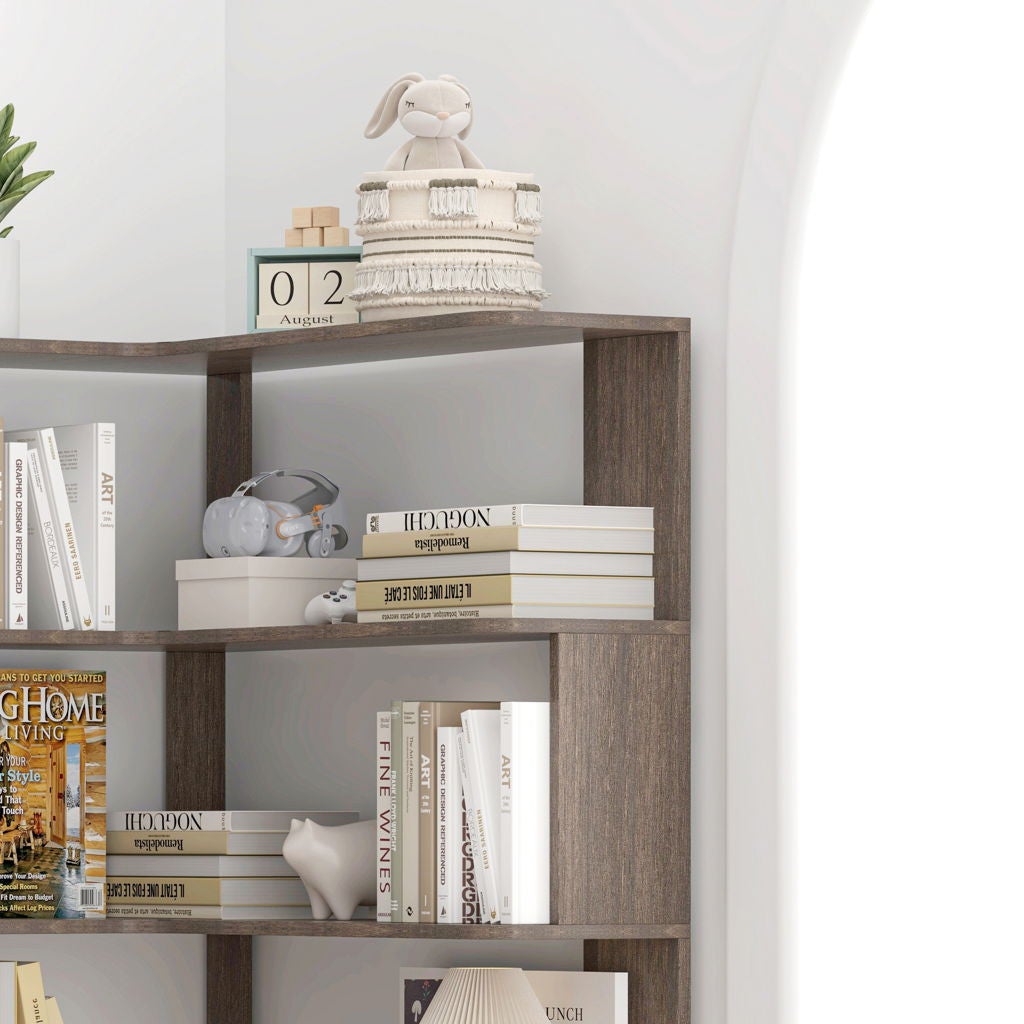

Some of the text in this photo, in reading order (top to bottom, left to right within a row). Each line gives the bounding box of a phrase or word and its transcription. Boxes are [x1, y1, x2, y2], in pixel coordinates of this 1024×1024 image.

[270, 269, 345, 306] 0 2
[279, 314, 335, 327] August
[15, 458, 23, 594] GRAPHIC DESIGN REFERENCED
[403, 507, 491, 531] NOGUCHI
[414, 536, 470, 551] Remodelista
[403, 586, 411, 601] LE
[412, 585, 427, 600] FOIS
[429, 584, 443, 599] UNE
[19, 673, 30, 682] TO
[32, 673, 47, 682] GET
[50, 674, 66, 683] YOU
[68, 674, 103, 683] STARTED
[5, 725, 65, 741] LIVING
[5, 756, 26, 766] YOUR
[7, 769, 41, 786] Style
[420, 754, 431, 789] ART
[10, 784, 18, 793] to
[5, 795, 22, 804] That
[2, 806, 24, 815] Touch
[379, 741, 391, 894] FINE WINES
[125, 812, 203, 831] NOGUCHI
[134, 838, 184, 851] Remodelista
[0, 883, 18, 891] Special
